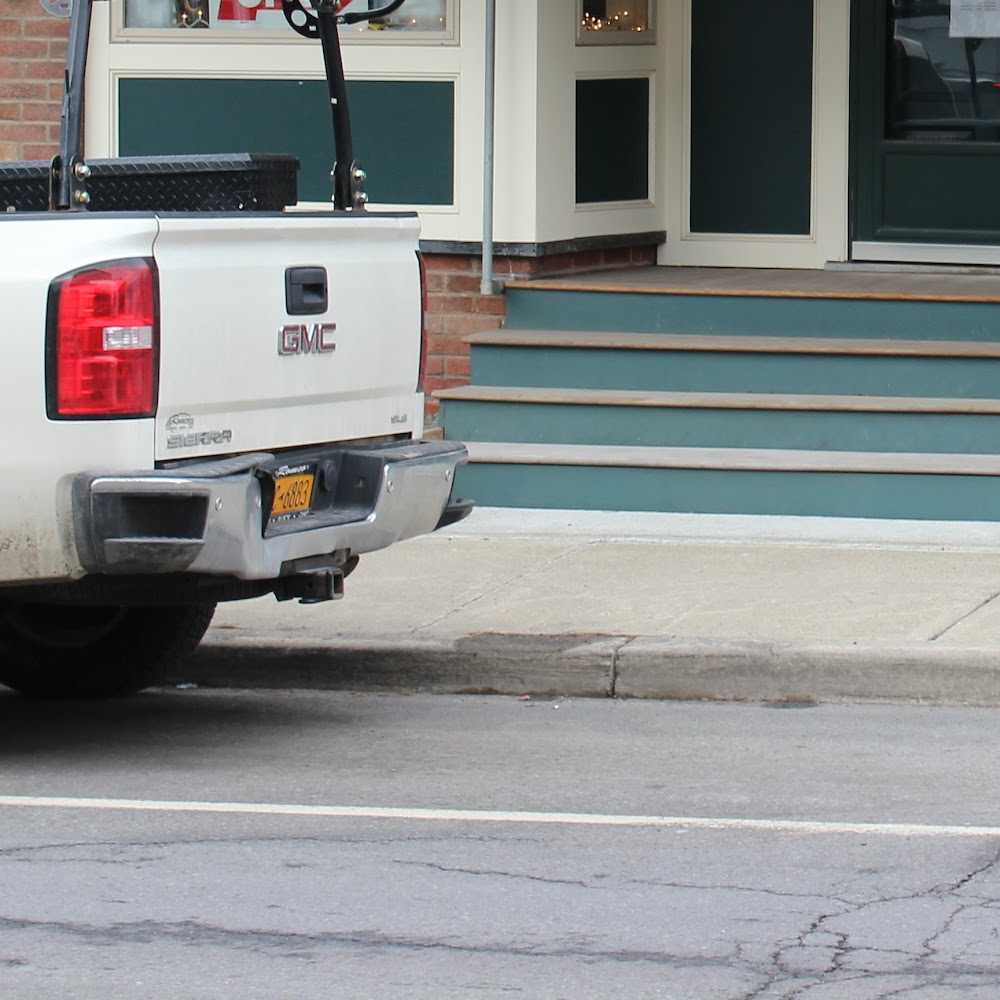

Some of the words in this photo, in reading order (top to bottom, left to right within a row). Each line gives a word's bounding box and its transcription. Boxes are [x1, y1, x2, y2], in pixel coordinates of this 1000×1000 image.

[278, 323, 336, 355] GMC
[166, 429, 232, 449] SIERRA
[283, 479, 310, 509] 6883
